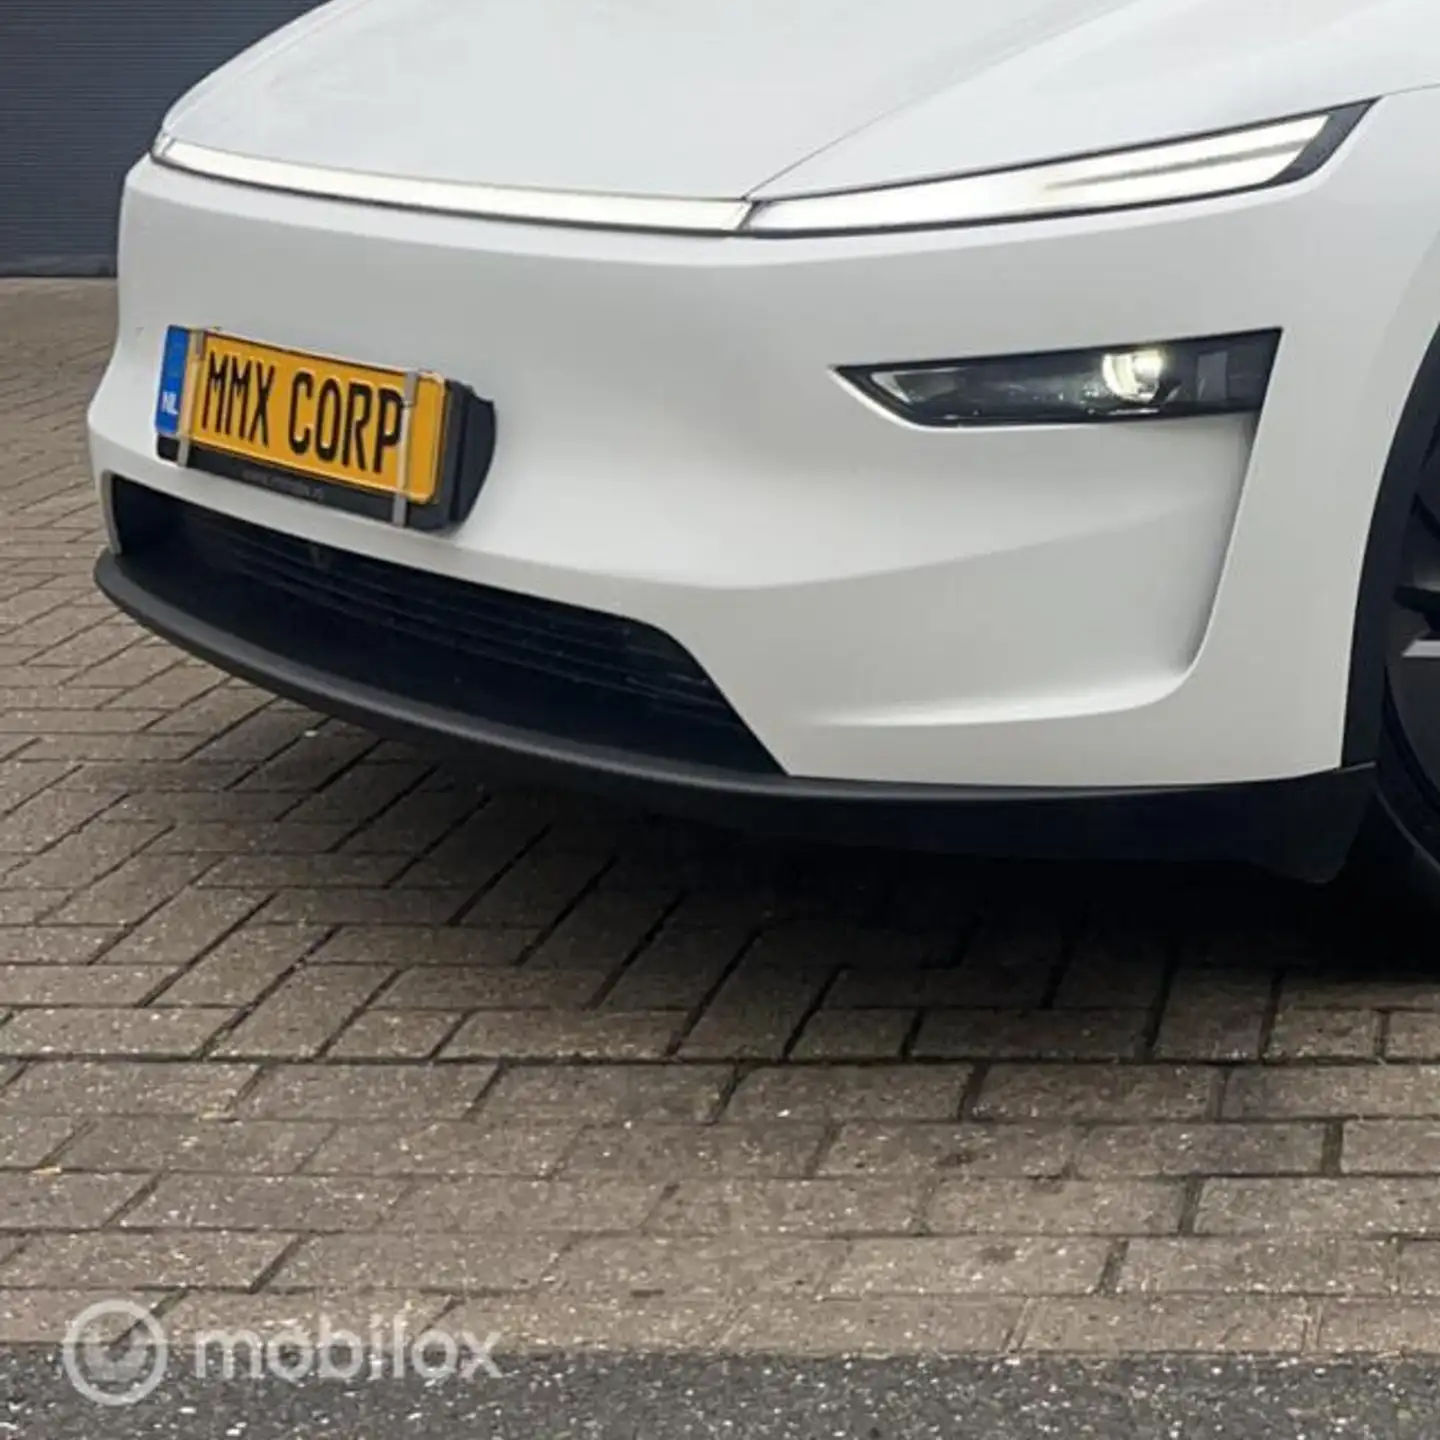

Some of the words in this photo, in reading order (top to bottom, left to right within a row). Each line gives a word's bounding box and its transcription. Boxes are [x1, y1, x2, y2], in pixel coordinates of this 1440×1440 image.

[162, 391, 179, 415] NL
[201, 351, 276, 448] MMX
[288, 371, 404, 473] CORP
